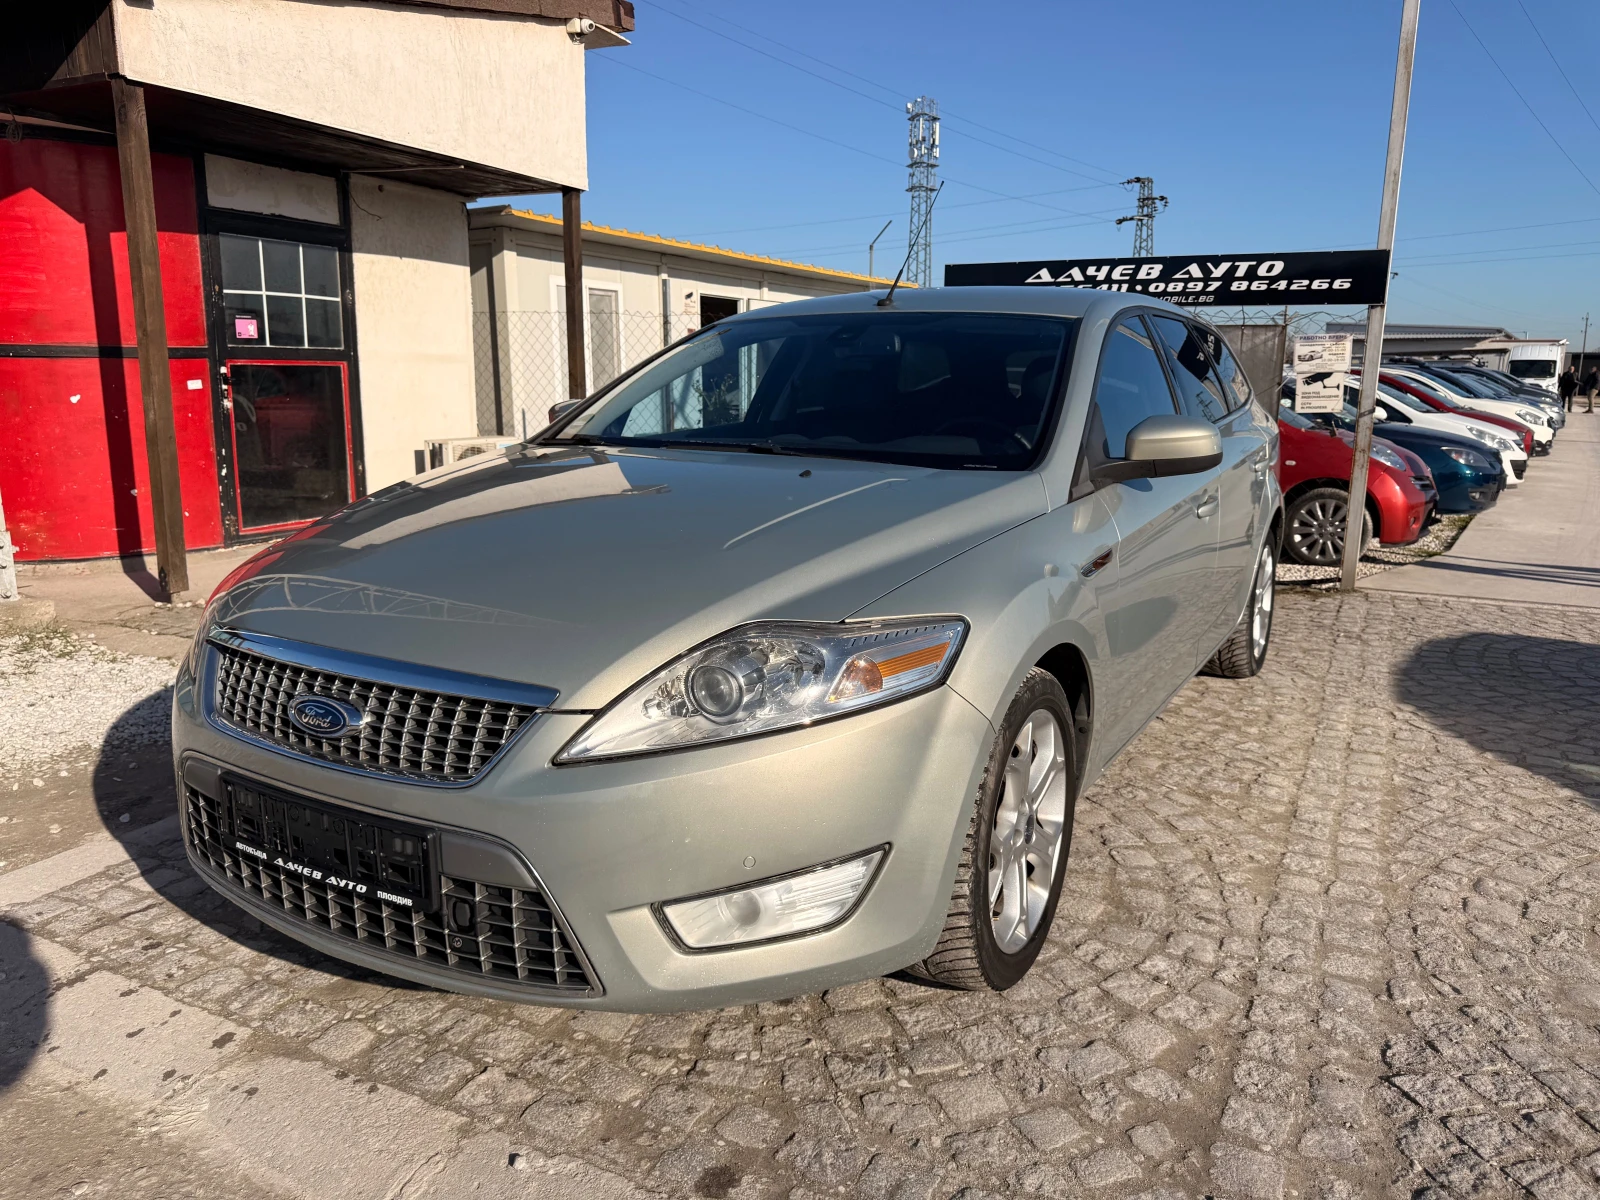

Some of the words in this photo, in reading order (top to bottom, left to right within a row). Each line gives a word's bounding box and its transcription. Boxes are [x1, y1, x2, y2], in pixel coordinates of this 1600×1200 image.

[1024, 264, 1163, 283] ДАЧЕВ
[1171, 260, 1285, 279] АУТО
[1148, 281, 1223, 293] 0897
[1230, 278, 1353, 291] 864266
[301, 705, 333, 728] Ford
[273, 857, 323, 880] ДАЧЕВ
[325, 875, 368, 894] АУТО
[377, 890, 413, 907] ПЛОВДИВ
